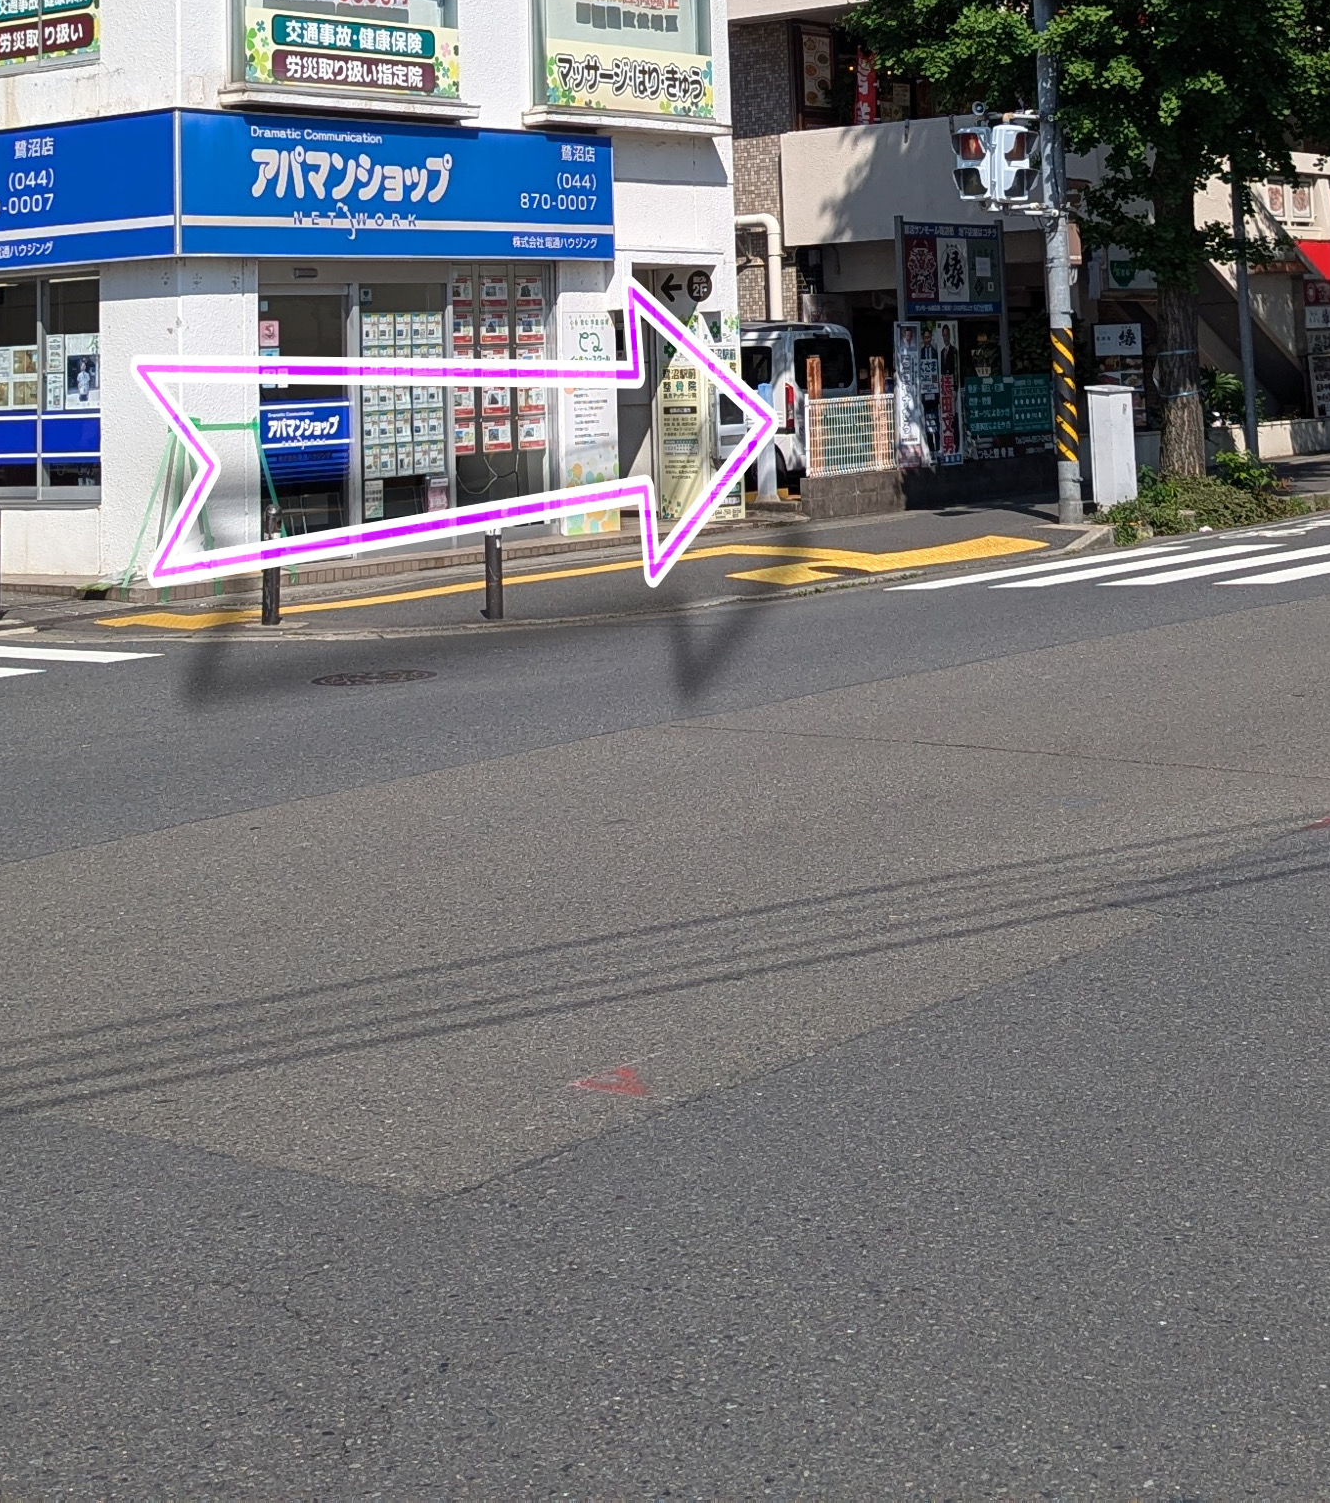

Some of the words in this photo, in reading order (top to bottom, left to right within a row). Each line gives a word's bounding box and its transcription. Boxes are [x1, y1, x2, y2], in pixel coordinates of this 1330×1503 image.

[0, 22, 83, 53] 労災取り扱い
[286, 20, 423, 55] 交通事故・健康保険
[286, 55, 423, 88] 労災取り扱い指定院
[557, 56, 704, 99] マッサージ・はり・きゅう
[250, 126, 301, 140] Dramatic
[304, 129, 383, 145] Communication
[14, 137, 55, 159] 鷺沼店
[561, 145, 595, 163] 鷺沼店
[8, 167, 55, 192] (044)
[251, 145, 453, 203] アパマンショップ
[556, 173, 597, 190] (044)
[520, 192, 598, 211] 870-0007
[692, 283, 708, 297] 2F
[268, 415, 340, 438] アパマンショップ
